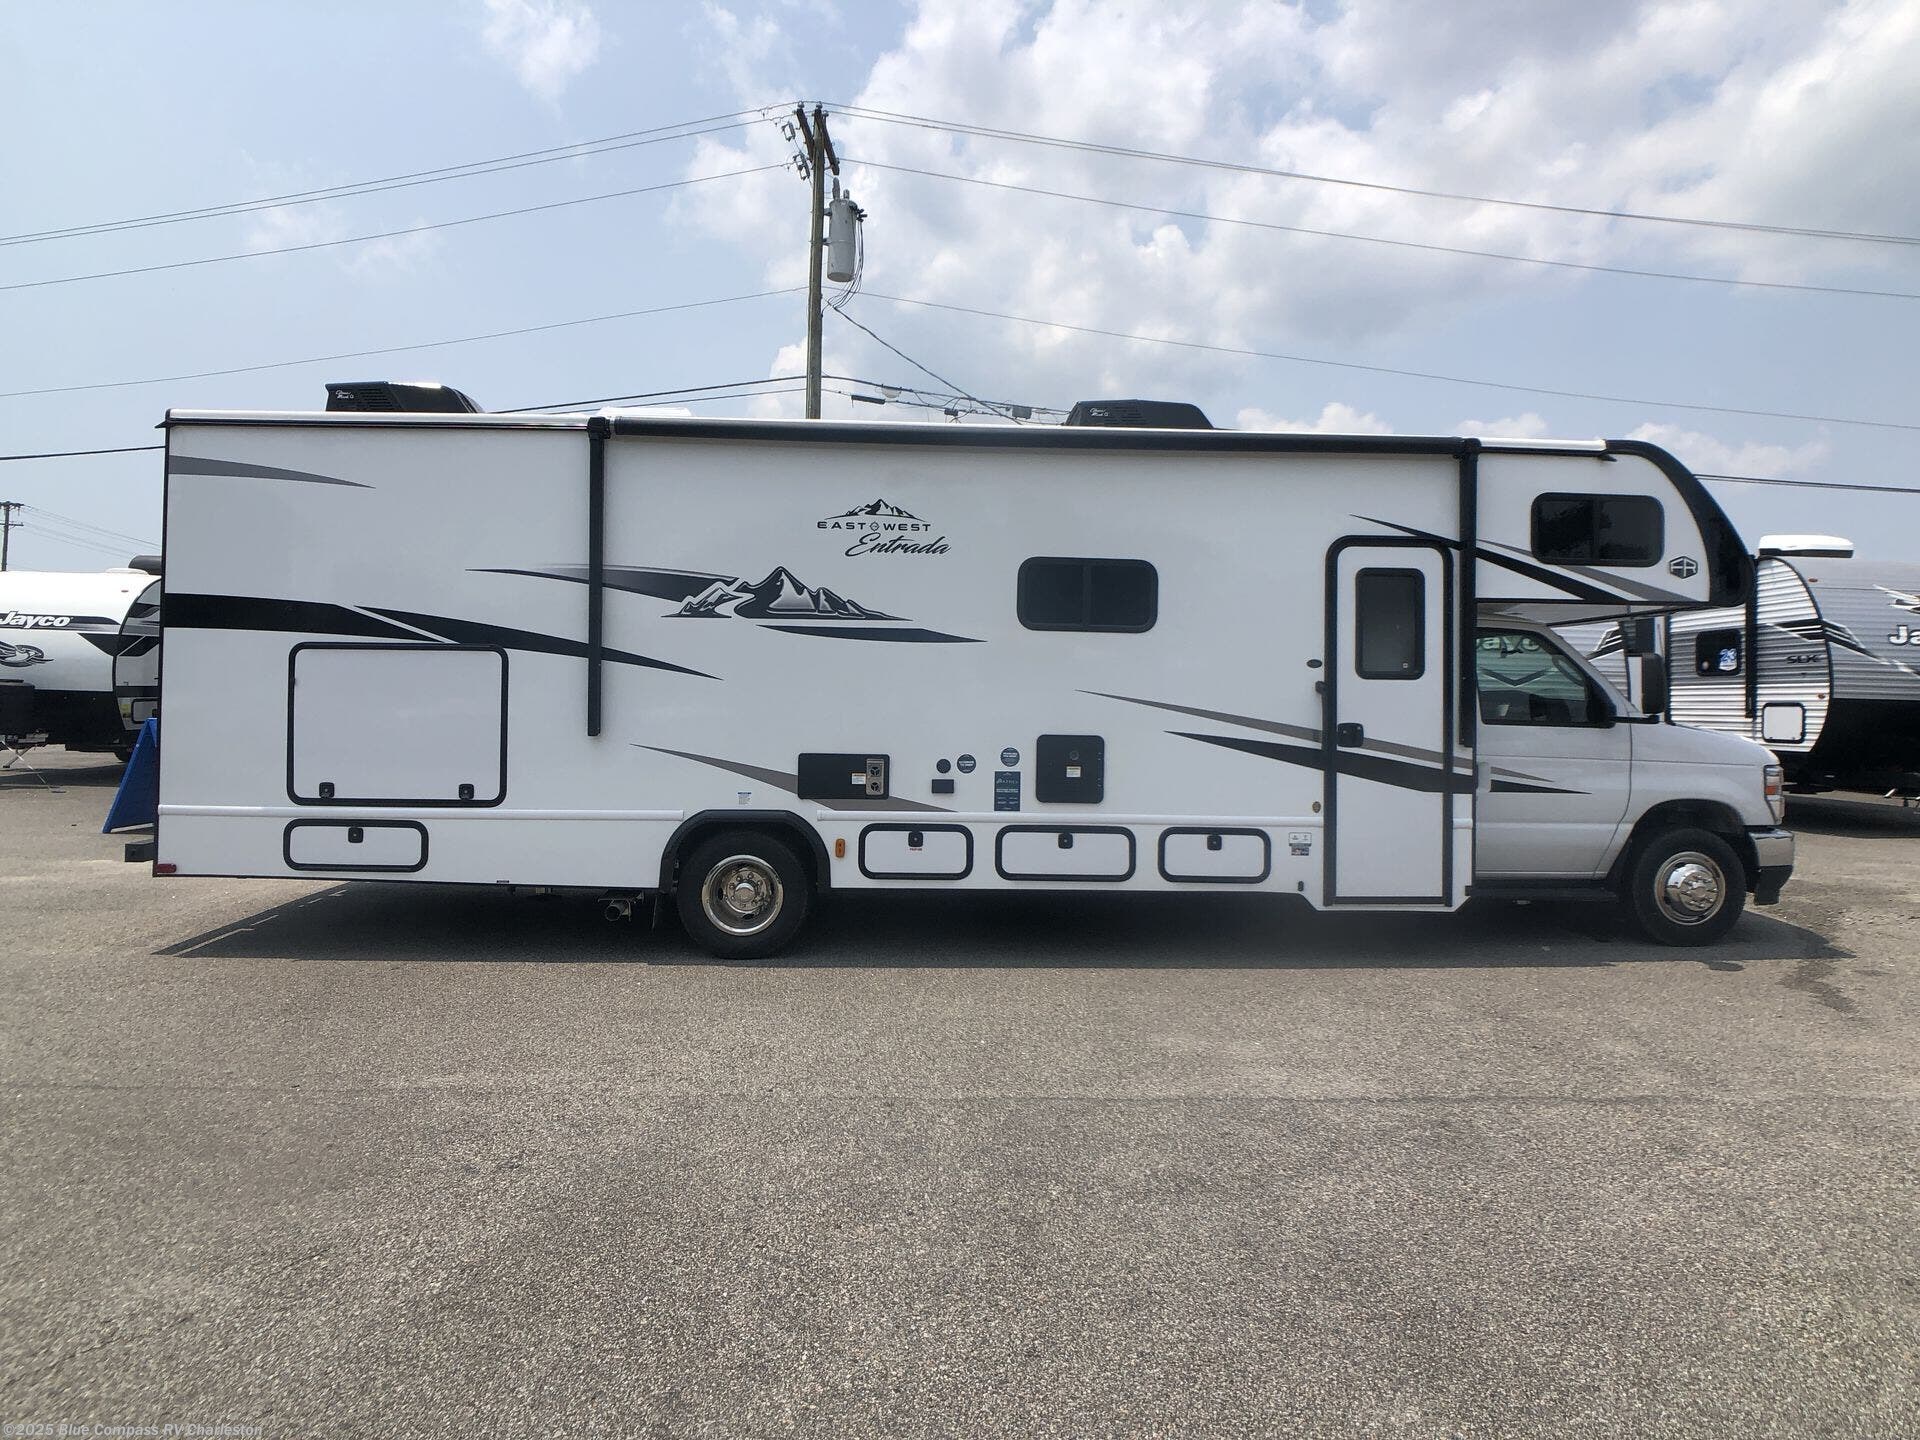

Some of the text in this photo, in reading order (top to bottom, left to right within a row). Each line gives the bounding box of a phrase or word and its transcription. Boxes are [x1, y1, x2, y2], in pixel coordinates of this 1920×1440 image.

[817, 521, 931, 532] EAST WEST
[844, 532, 951, 557] Entrada
[0, 610, 70, 629] Jayco
